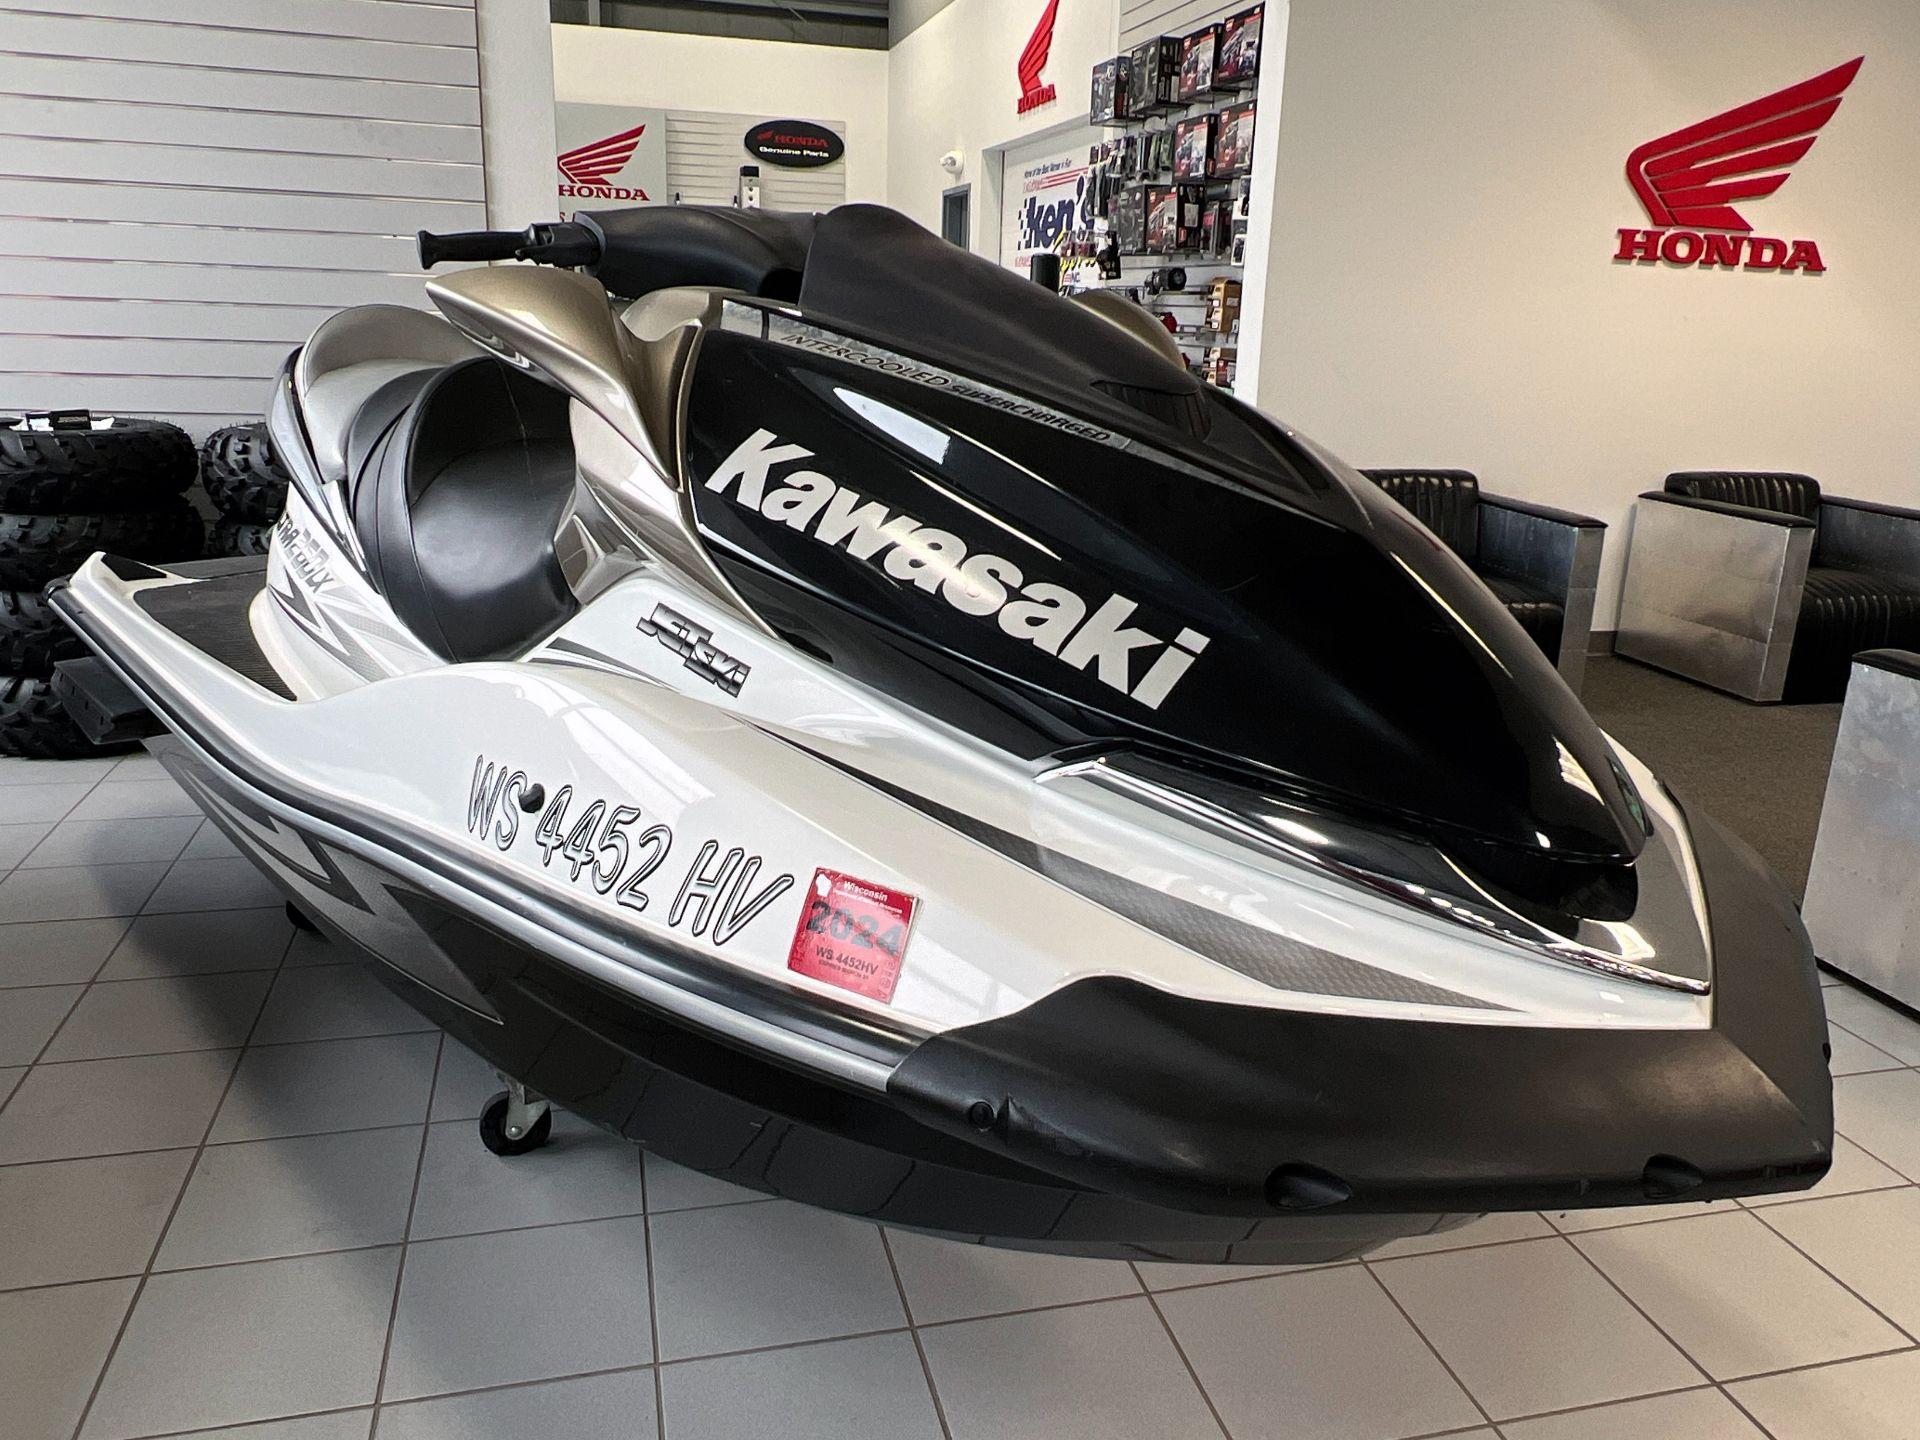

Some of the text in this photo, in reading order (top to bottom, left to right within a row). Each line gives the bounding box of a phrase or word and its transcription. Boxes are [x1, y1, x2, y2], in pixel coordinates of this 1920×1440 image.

[1017, 84, 1056, 114] HONDA
[759, 146, 829, 158] Genuine Parts
[775, 135, 829, 147] HONDA
[558, 184, 650, 201] HONDA
[1614, 228, 1826, 272] HONDA
[781, 334, 1110, 441] INTERCOOLED SUPERCHARGED
[705, 428, 1211, 710] Kawasaki
[467, 754, 795, 945] WS 4452 HV
[844, 881, 888, 901] Wisconsin
[806, 901, 903, 955] 2024
[815, 945, 834, 960] WS
[836, 953, 879, 976] 4452HV
